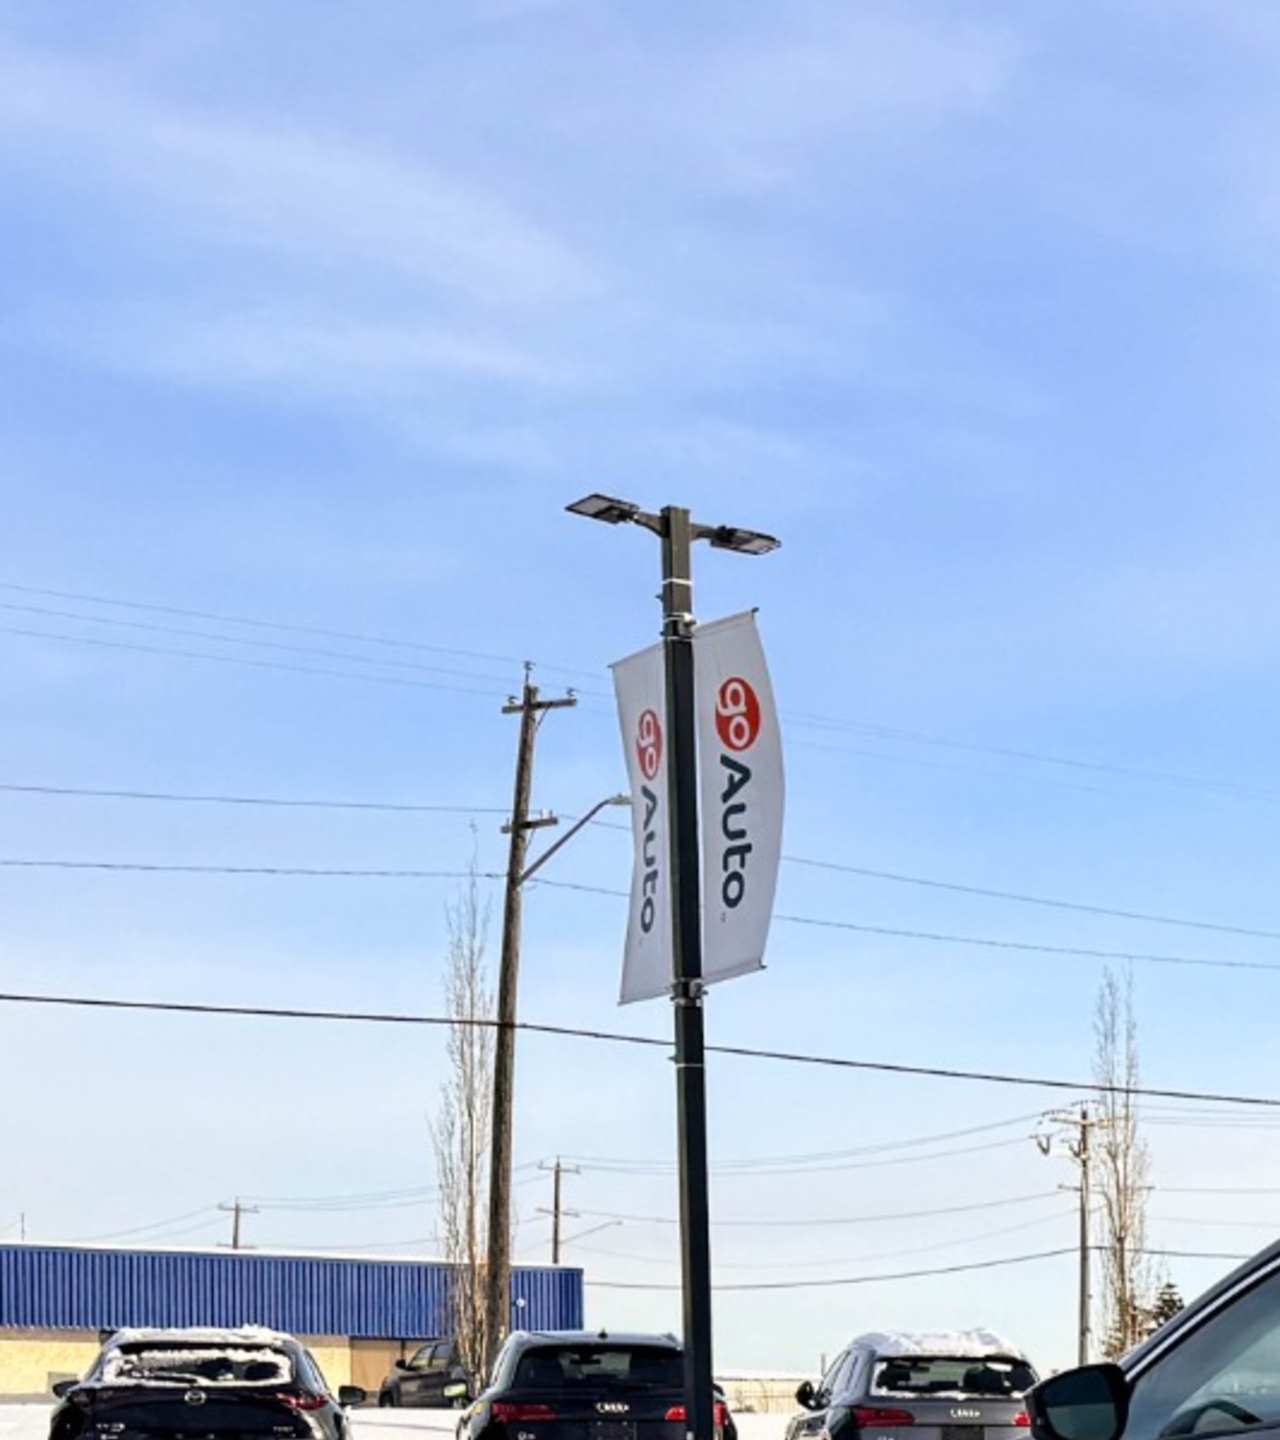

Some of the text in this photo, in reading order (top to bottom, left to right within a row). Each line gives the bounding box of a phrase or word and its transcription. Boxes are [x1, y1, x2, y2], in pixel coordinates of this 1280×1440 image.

[637, 711, 661, 935] go Auto
[716, 678, 757, 909] go Auto
